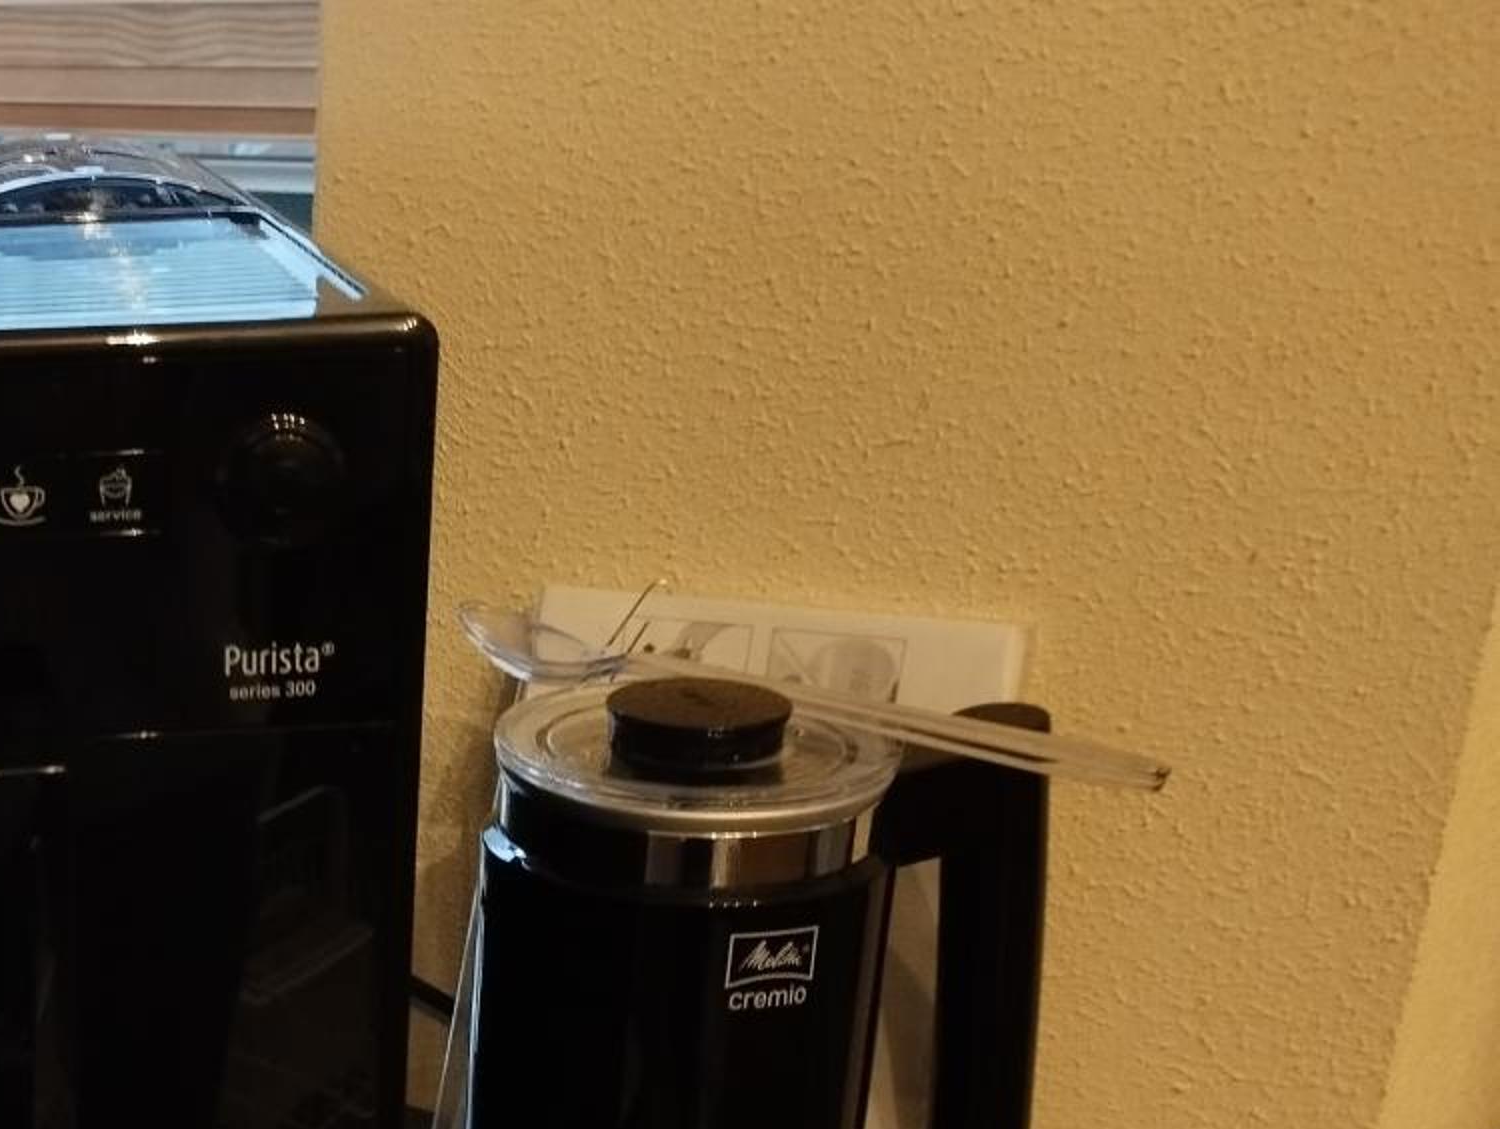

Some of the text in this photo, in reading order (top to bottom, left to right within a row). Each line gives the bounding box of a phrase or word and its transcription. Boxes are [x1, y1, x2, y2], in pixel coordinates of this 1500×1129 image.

[88, 510, 143, 523] service
[228, 680, 317, 700] series 300
[727, 984, 808, 1011] cremio
